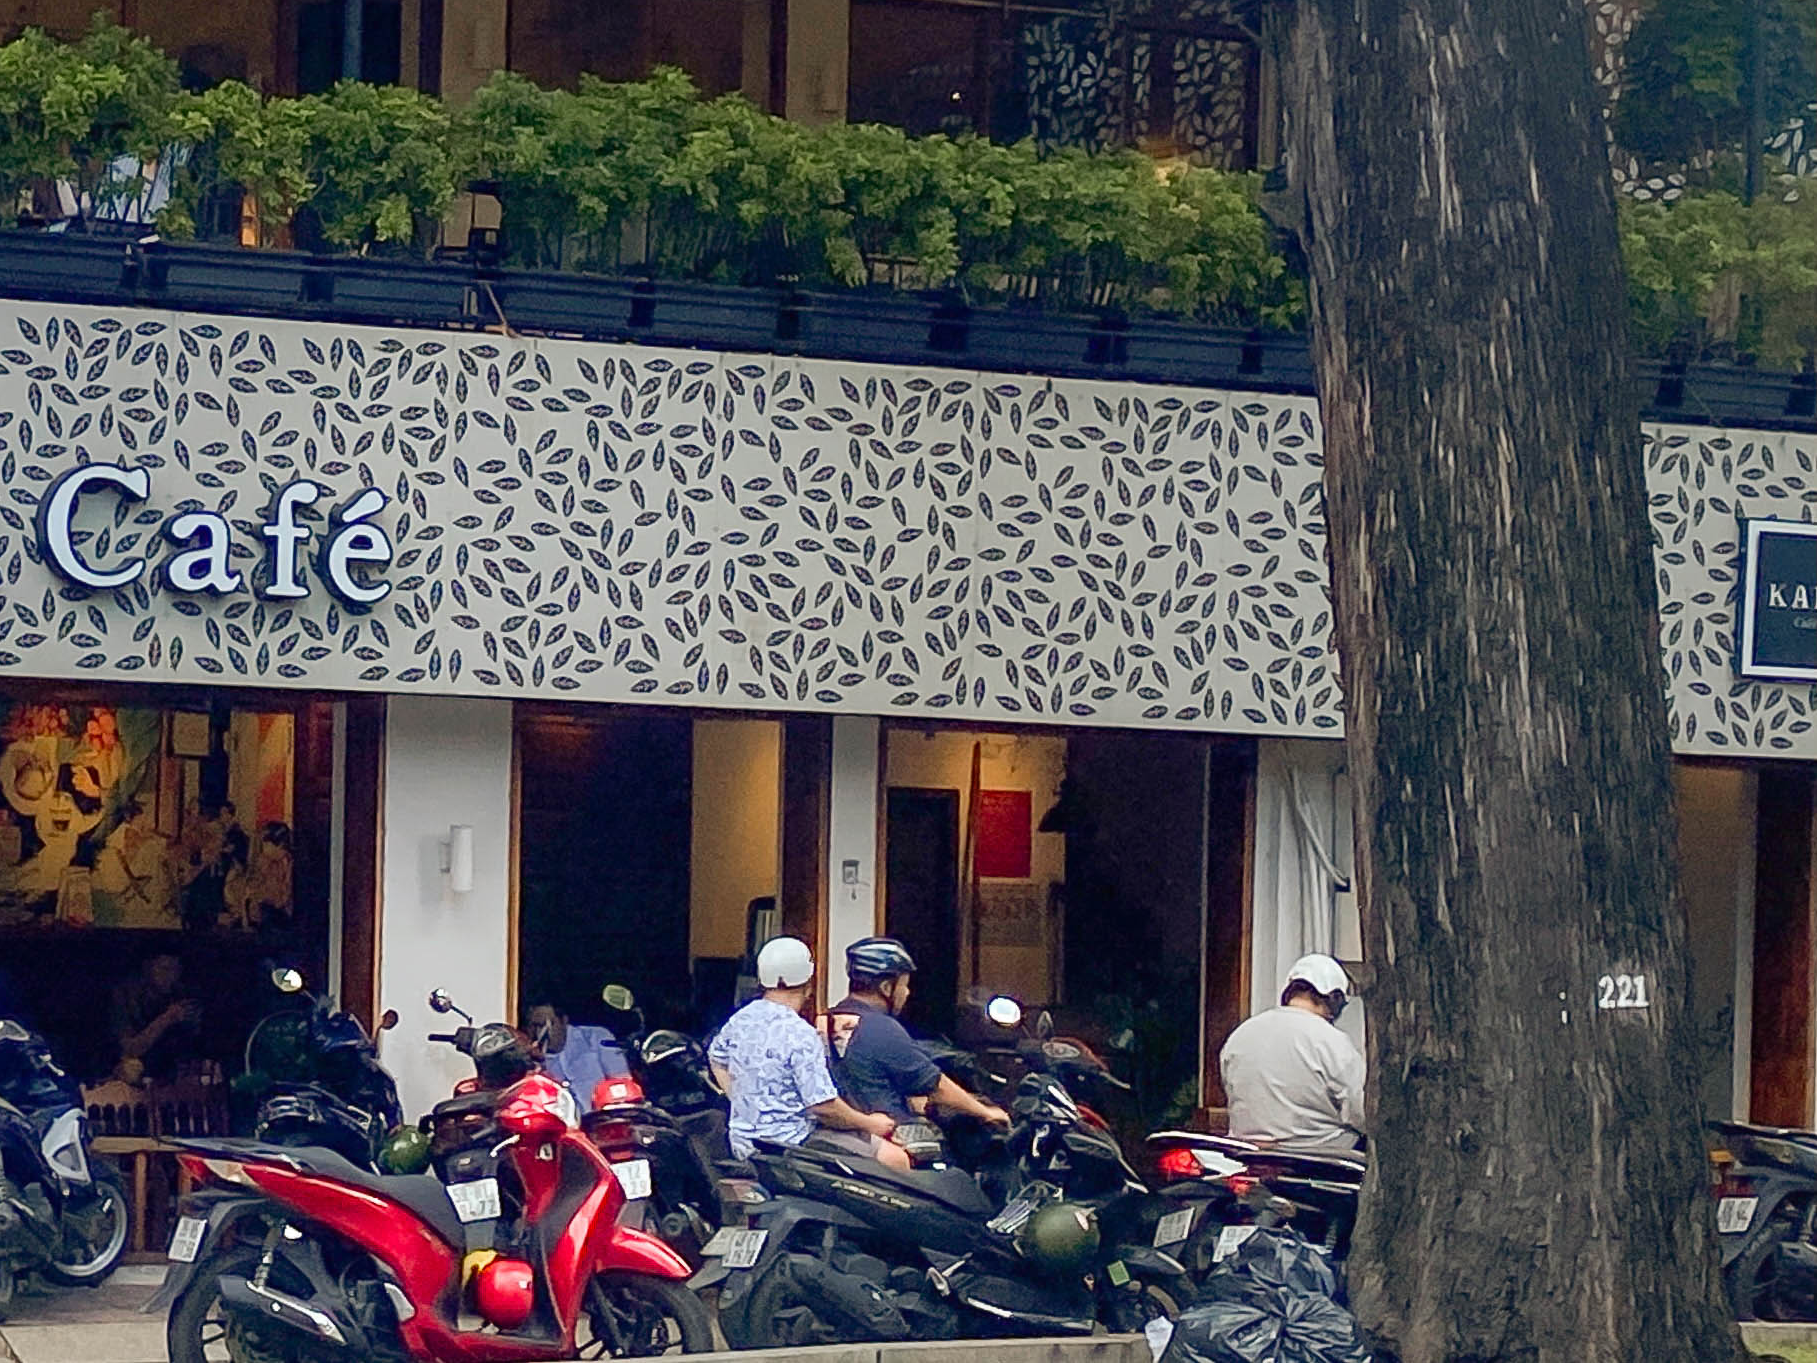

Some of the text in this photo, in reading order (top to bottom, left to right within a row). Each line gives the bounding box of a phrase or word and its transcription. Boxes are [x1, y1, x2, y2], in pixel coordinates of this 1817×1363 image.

[44, 465, 393, 604] Café
[1768, 583, 1817, 610] KA
[1598, 973, 1650, 1009] 221
